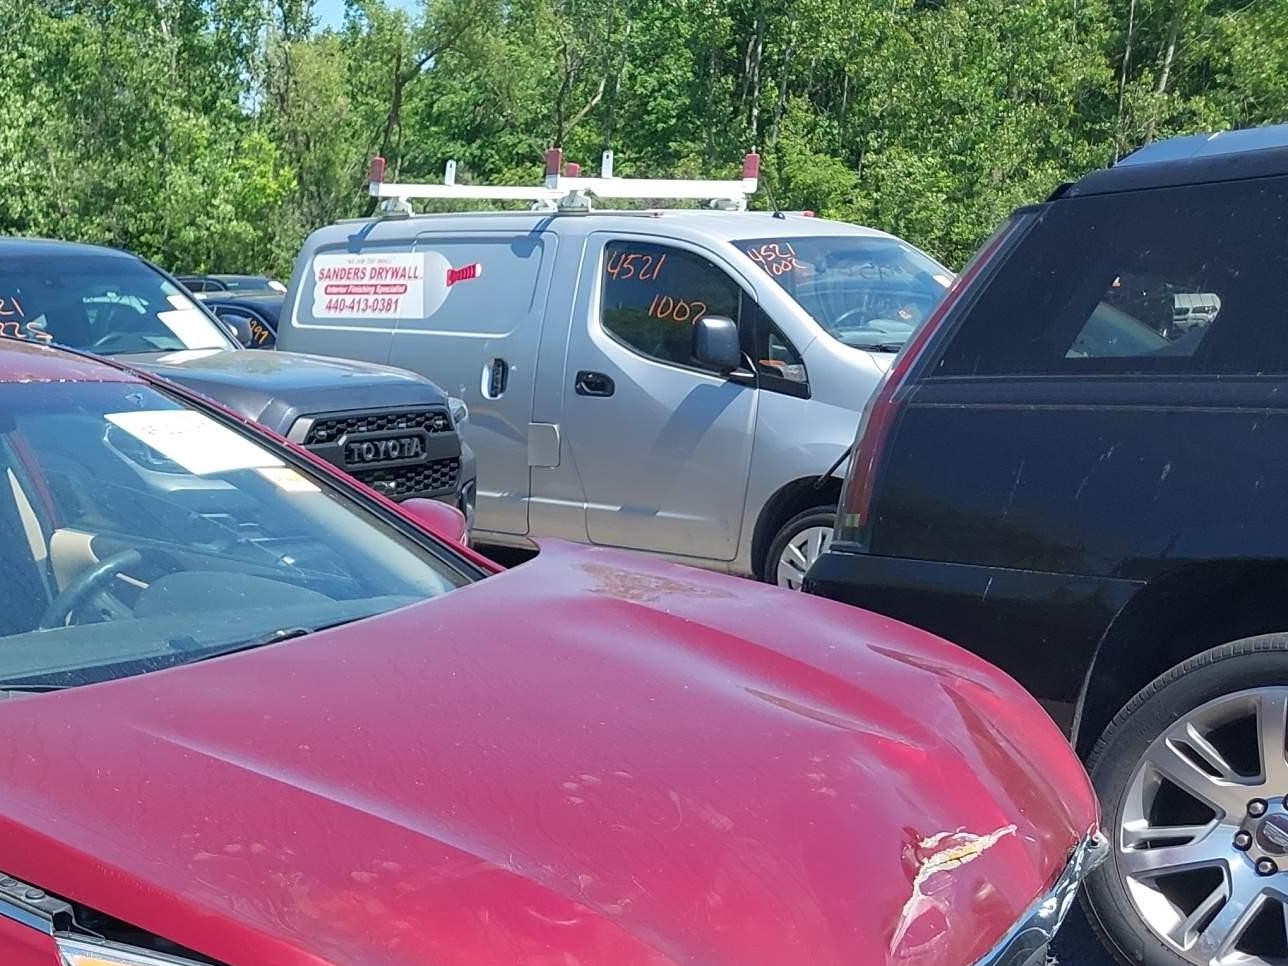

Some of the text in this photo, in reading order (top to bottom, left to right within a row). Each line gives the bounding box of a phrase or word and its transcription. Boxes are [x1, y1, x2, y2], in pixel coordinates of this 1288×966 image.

[746, 242, 796, 265] 4521
[318, 267, 367, 281] SANDERS
[607, 251, 667, 281] 4521
[326, 298, 400, 313] 440-413-0381
[348, 437, 423, 461] TOYOTA
